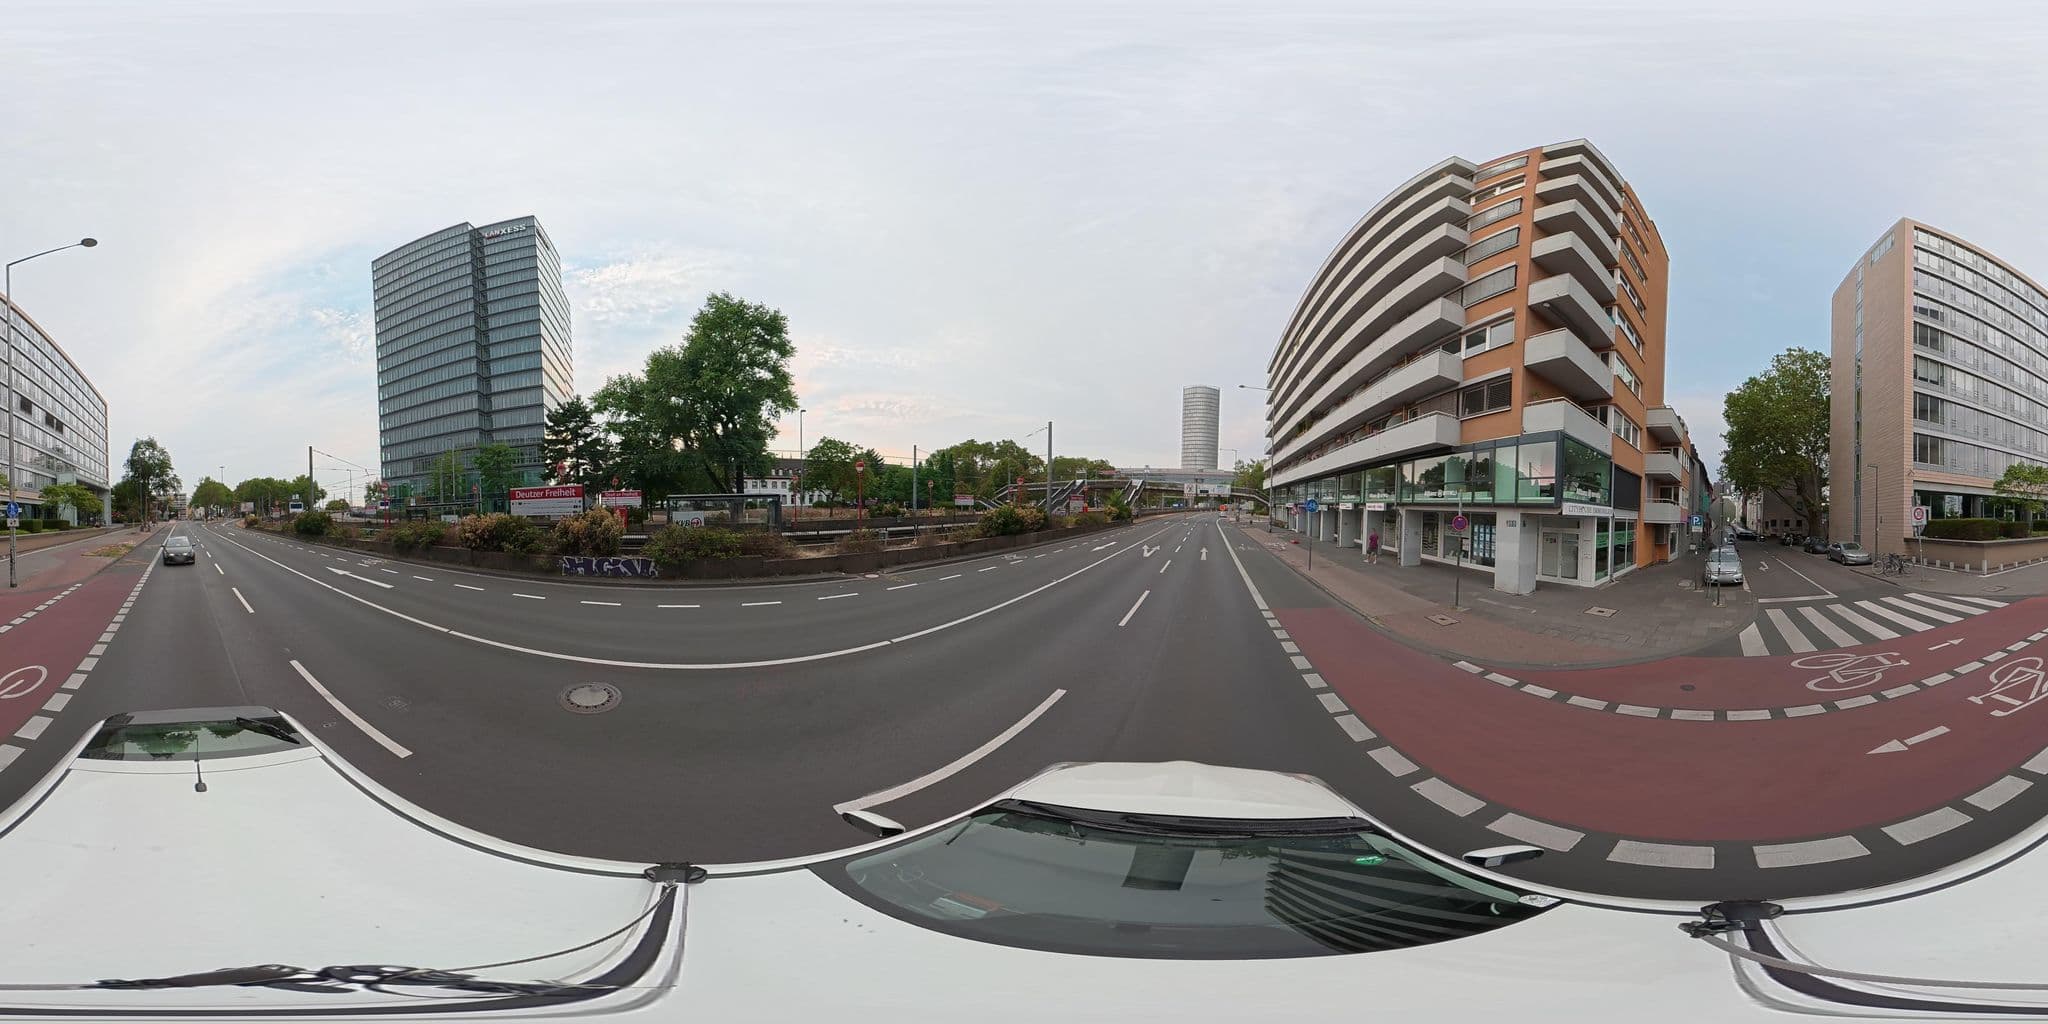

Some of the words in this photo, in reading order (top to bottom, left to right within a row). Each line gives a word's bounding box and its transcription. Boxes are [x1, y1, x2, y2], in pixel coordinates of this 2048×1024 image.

[484, 224, 526, 237] LANXESS
[515, 490, 543, 499] Deutzer
[545, 487, 576, 497] Freiheit
